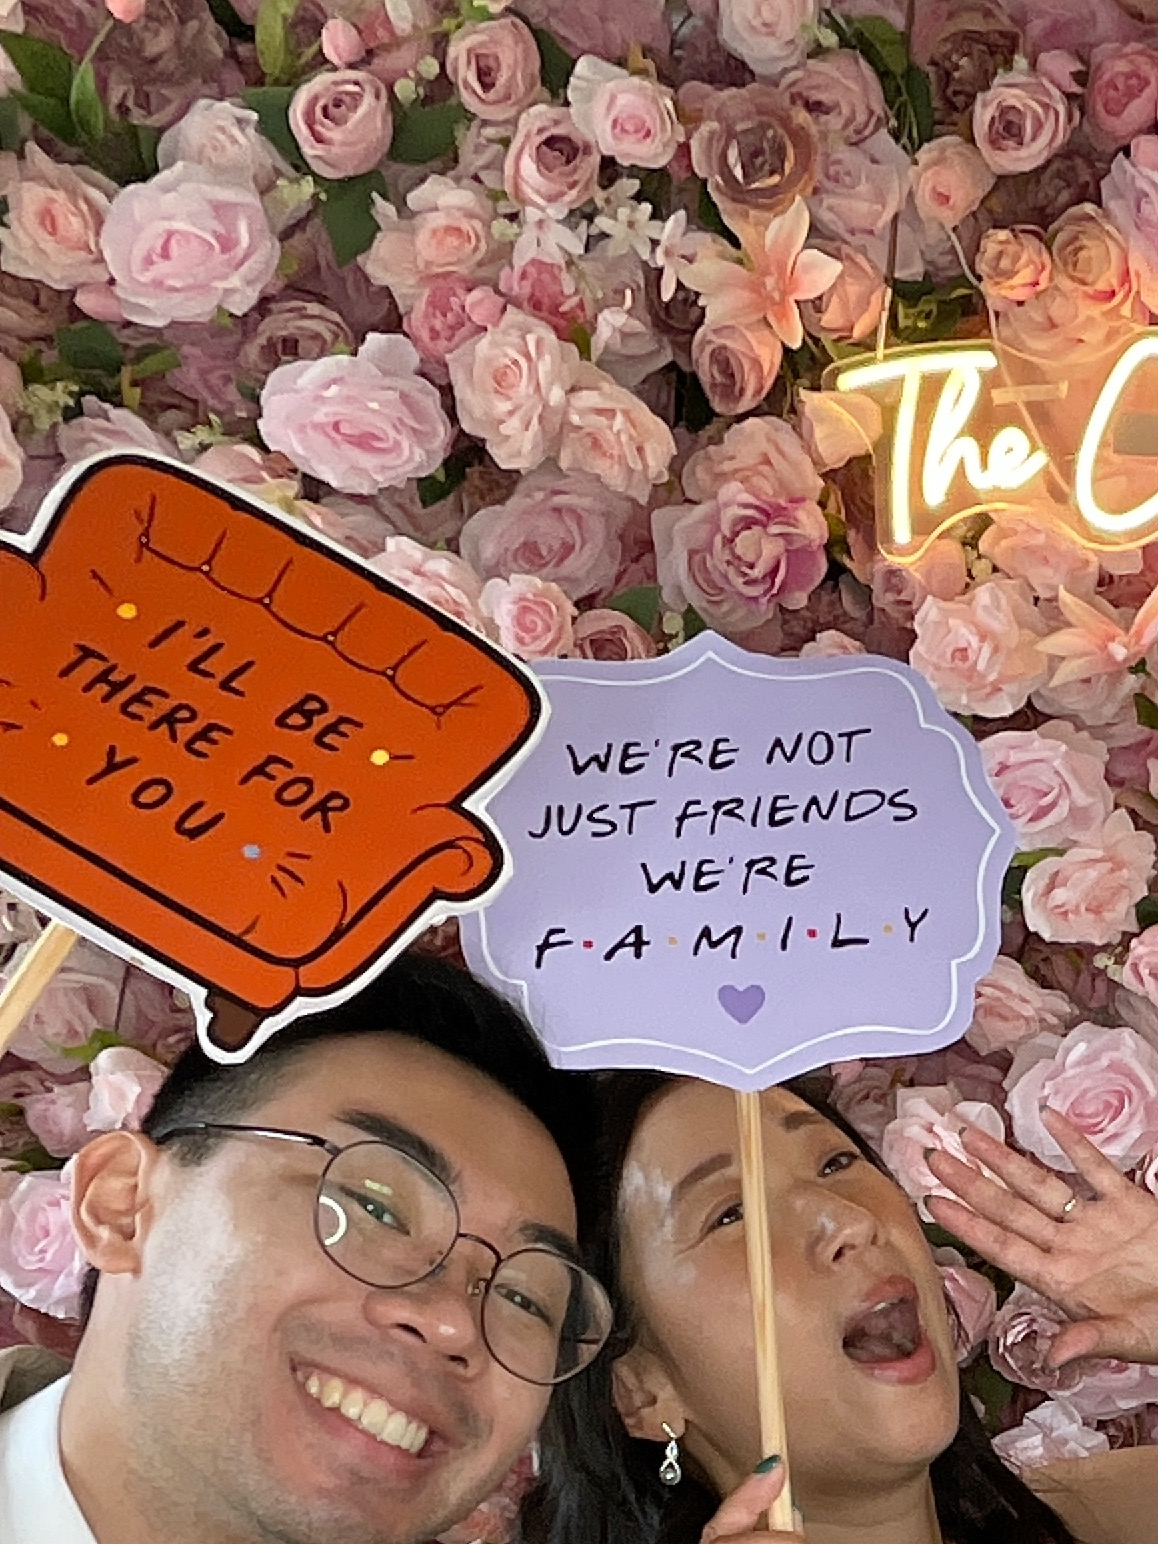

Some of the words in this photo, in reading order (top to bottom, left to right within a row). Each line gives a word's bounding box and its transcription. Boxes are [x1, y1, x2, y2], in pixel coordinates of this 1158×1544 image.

[836, 348, 1047, 546] The
[147, 618, 257, 698] I'LL
[273, 692, 364, 753] BE
[57, 642, 235, 760] THERE
[238, 753, 352, 835] FOR
[564, 736, 741, 779] WE'RE
[765, 728, 873, 767] NOT
[85, 743, 227, 842] YOU
[527, 798, 658, 841] JUST
[674, 787, 919, 840] FRIENDS
[639, 853, 817, 897] WE'RE
